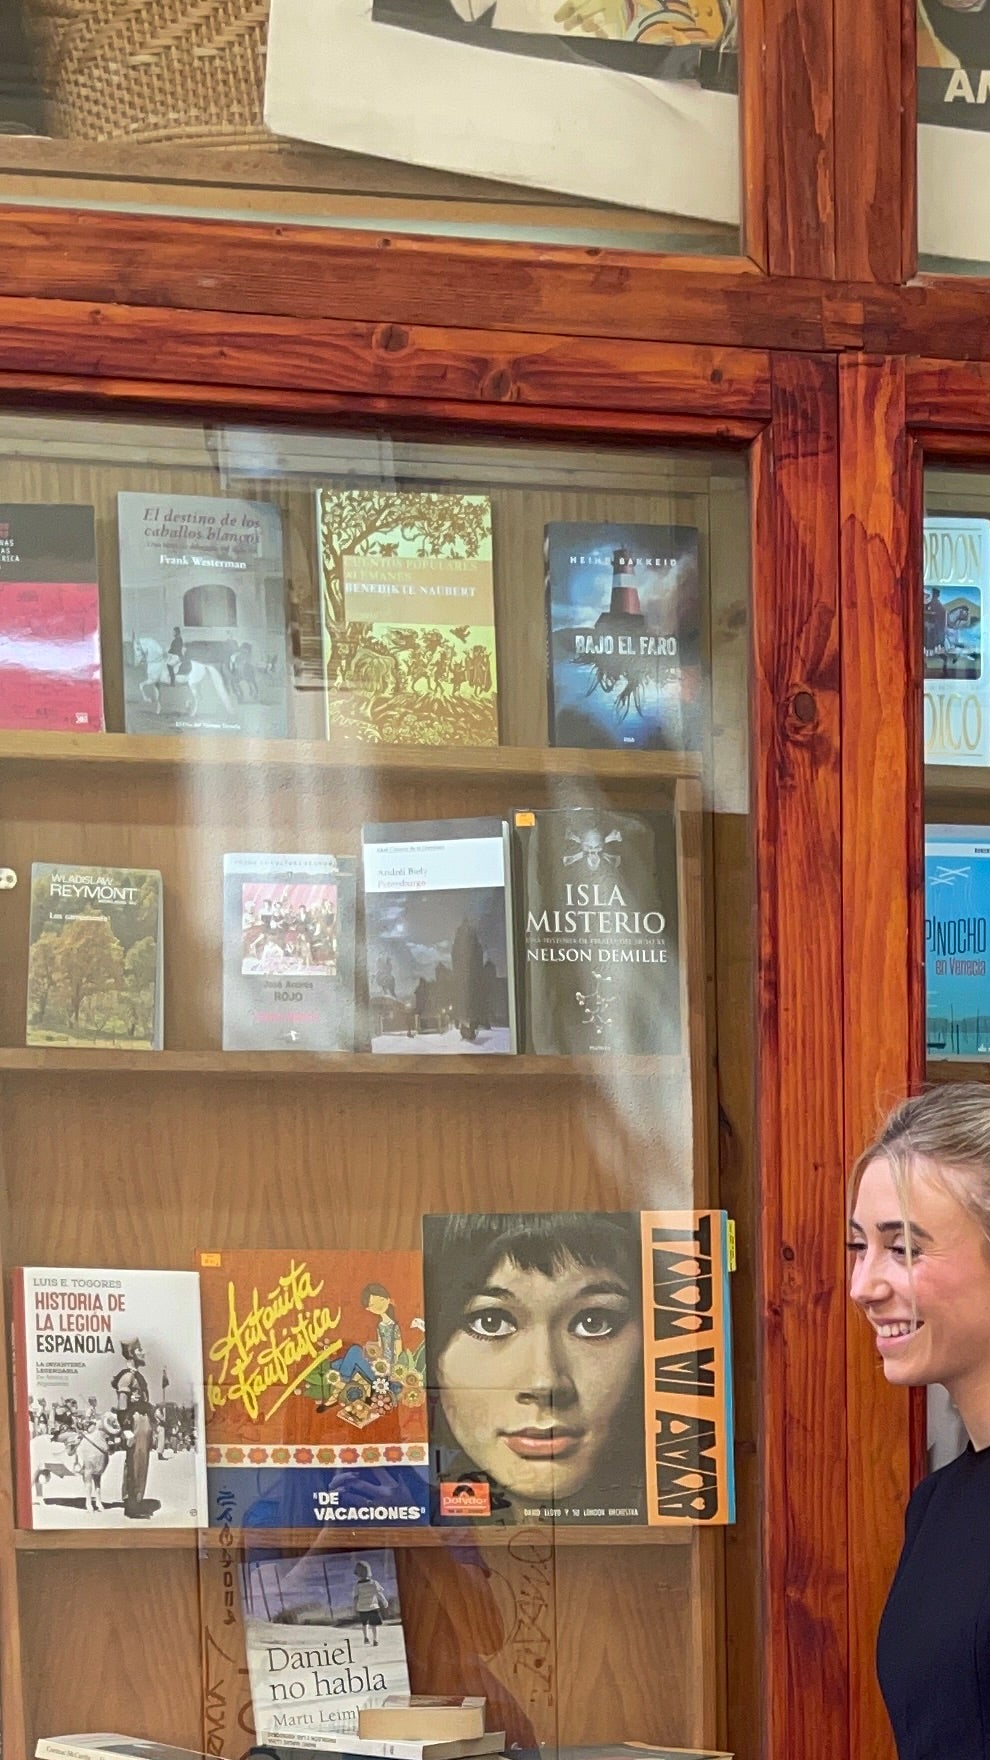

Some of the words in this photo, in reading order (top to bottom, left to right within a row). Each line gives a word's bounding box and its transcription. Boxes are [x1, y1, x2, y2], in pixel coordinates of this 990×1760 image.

[143, 507, 160, 521] El
[164, 509, 216, 525] destino
[220, 513, 238, 527] de
[241, 514, 261, 529] los
[144, 523, 202, 540] caballos
[159, 554, 189, 566] Frank
[191, 556, 247, 570] Westerman
[619, 556, 678, 568] BAKKEID
[575, 635, 614, 656] BAJO
[618, 636, 637, 656] EL
[639, 636, 678, 657] FARO
[51, 873, 115, 887] WLADISLAW
[50, 884, 138, 902] REYMONT
[565, 884, 627, 907] ISLA
[526, 910, 666, 935] MISTERIO
[527, 949, 593, 963] NELSON
[598, 949, 668, 963] DEMILLE
[949, 958, 987, 977] Venecia
[274, 991, 303, 1003] ROJO
[33, 1278, 59, 1288] LUIS
[35, 1291, 104, 1312] HISTORIA
[107, 1293, 126, 1313] DE
[35, 1314, 55, 1332] LA
[59, 1310, 112, 1333] LEGIÓN
[36, 1333, 116, 1354] ESPAÑOLA
[267, 1638, 356, 1673] Daniel
[269, 1679, 306, 1701] no
[312, 1665, 388, 1697] habla
[272, 1709, 314, 1728] Marti
